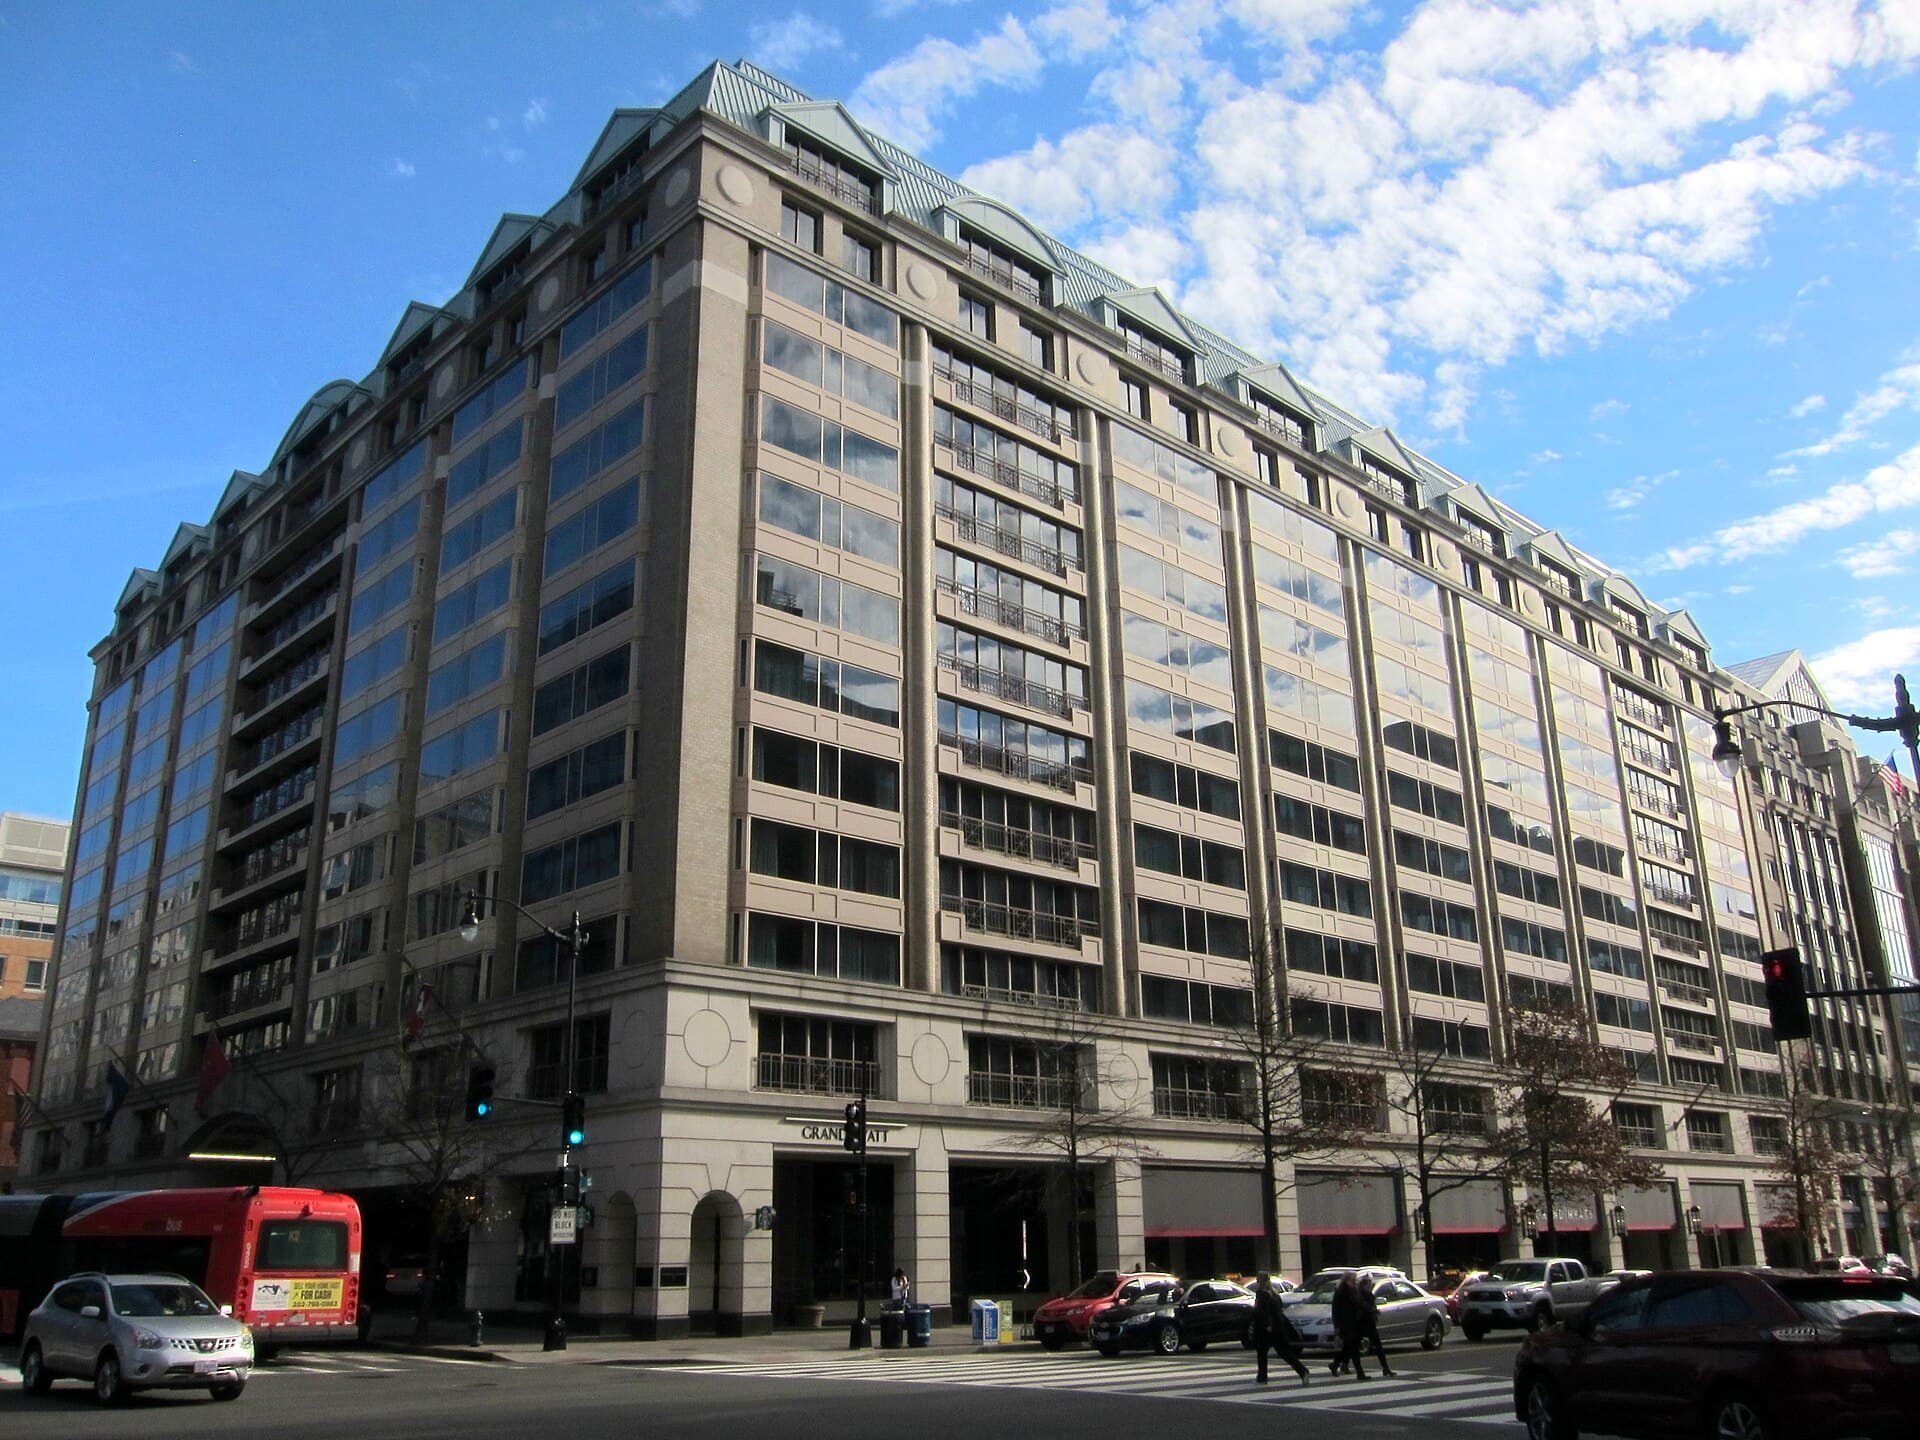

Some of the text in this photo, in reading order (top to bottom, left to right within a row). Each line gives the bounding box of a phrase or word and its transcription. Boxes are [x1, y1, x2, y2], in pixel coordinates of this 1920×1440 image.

[866, 1130, 889, 1143] ATT
[555, 1221, 572, 1229] BLOCK
[301, 1290, 332, 1300] FOR CASH
